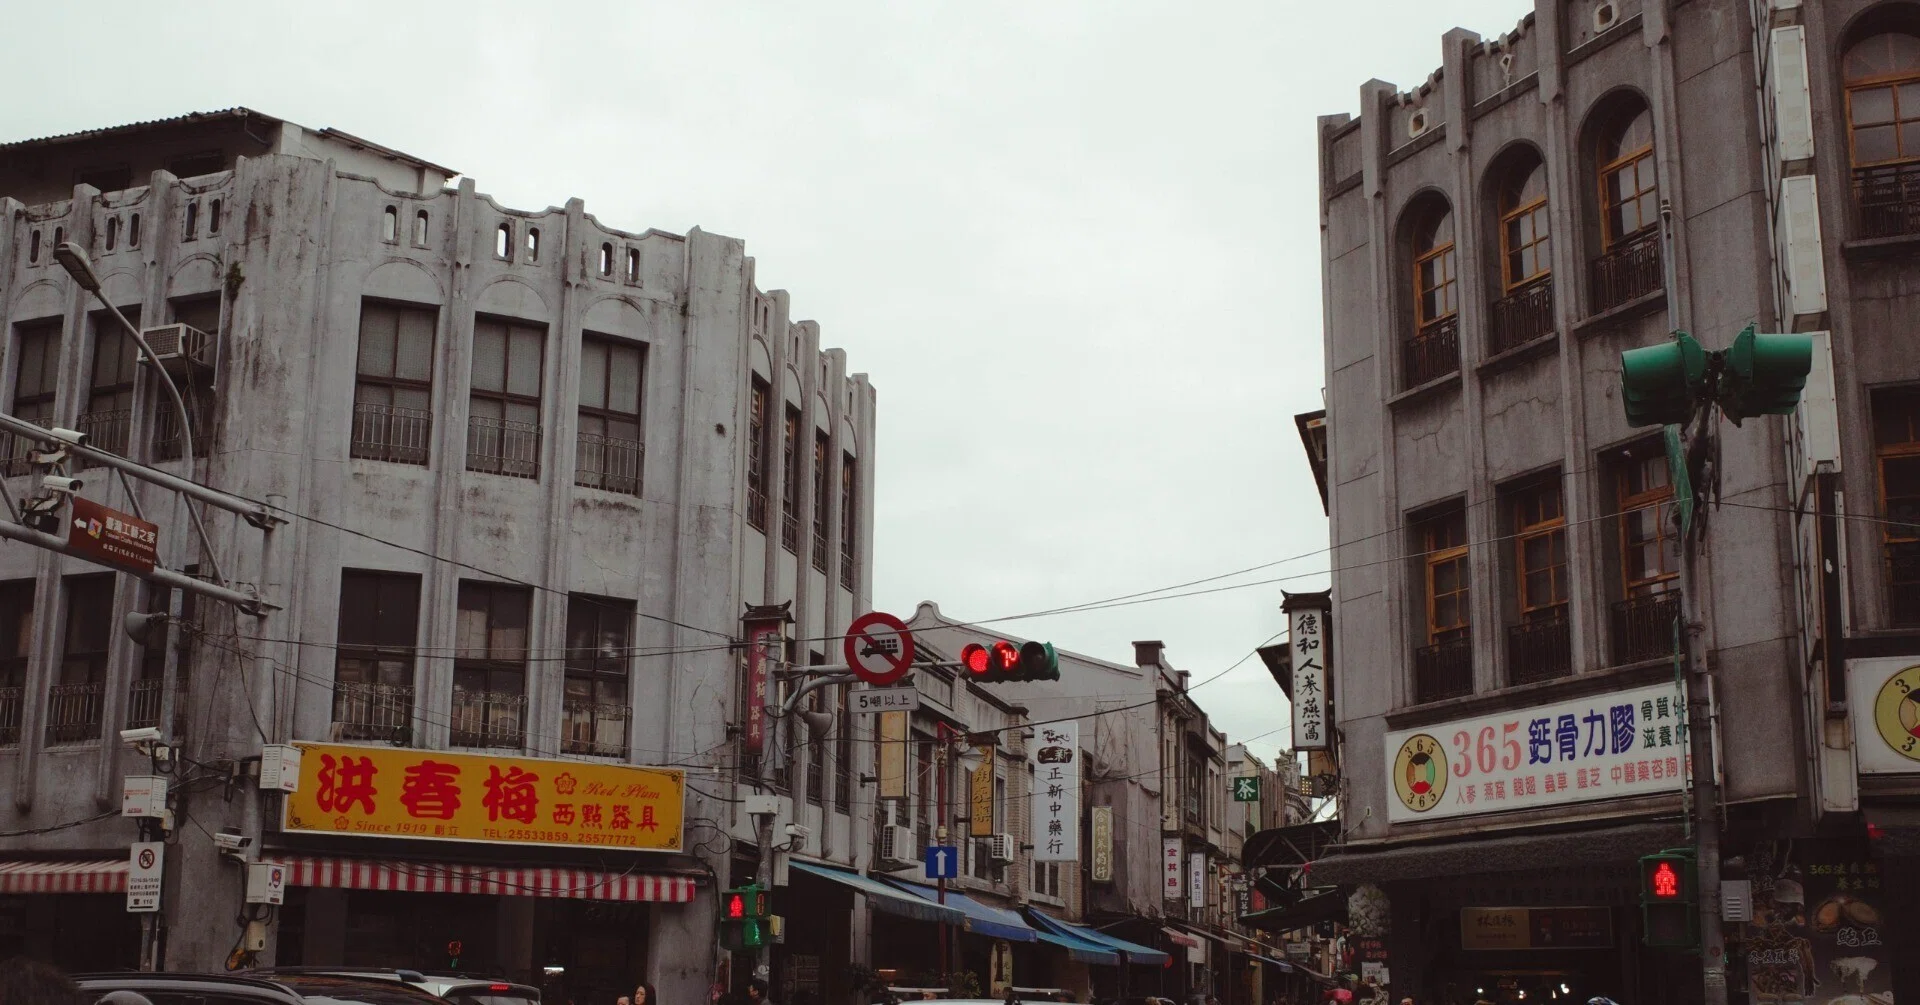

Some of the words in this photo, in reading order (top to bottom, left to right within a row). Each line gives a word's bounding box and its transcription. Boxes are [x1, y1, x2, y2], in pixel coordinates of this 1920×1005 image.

[1453, 720, 1522, 778] 365
[1528, 703, 1635, 766] 鈣骨力膠
[316, 753, 541, 825] 洪春梅
[582, 782, 623, 798] Red
[624, 783, 661, 801] Plum
[1236, 777, 1257, 801] 茶
[553, 803, 660, 833] 西點器具
[1046, 767, 1064, 855] 正新中藥行
[355, 819, 392, 833] Since
[396, 822, 428, 836] 1919
[577, 832, 637, 846] 25577772
